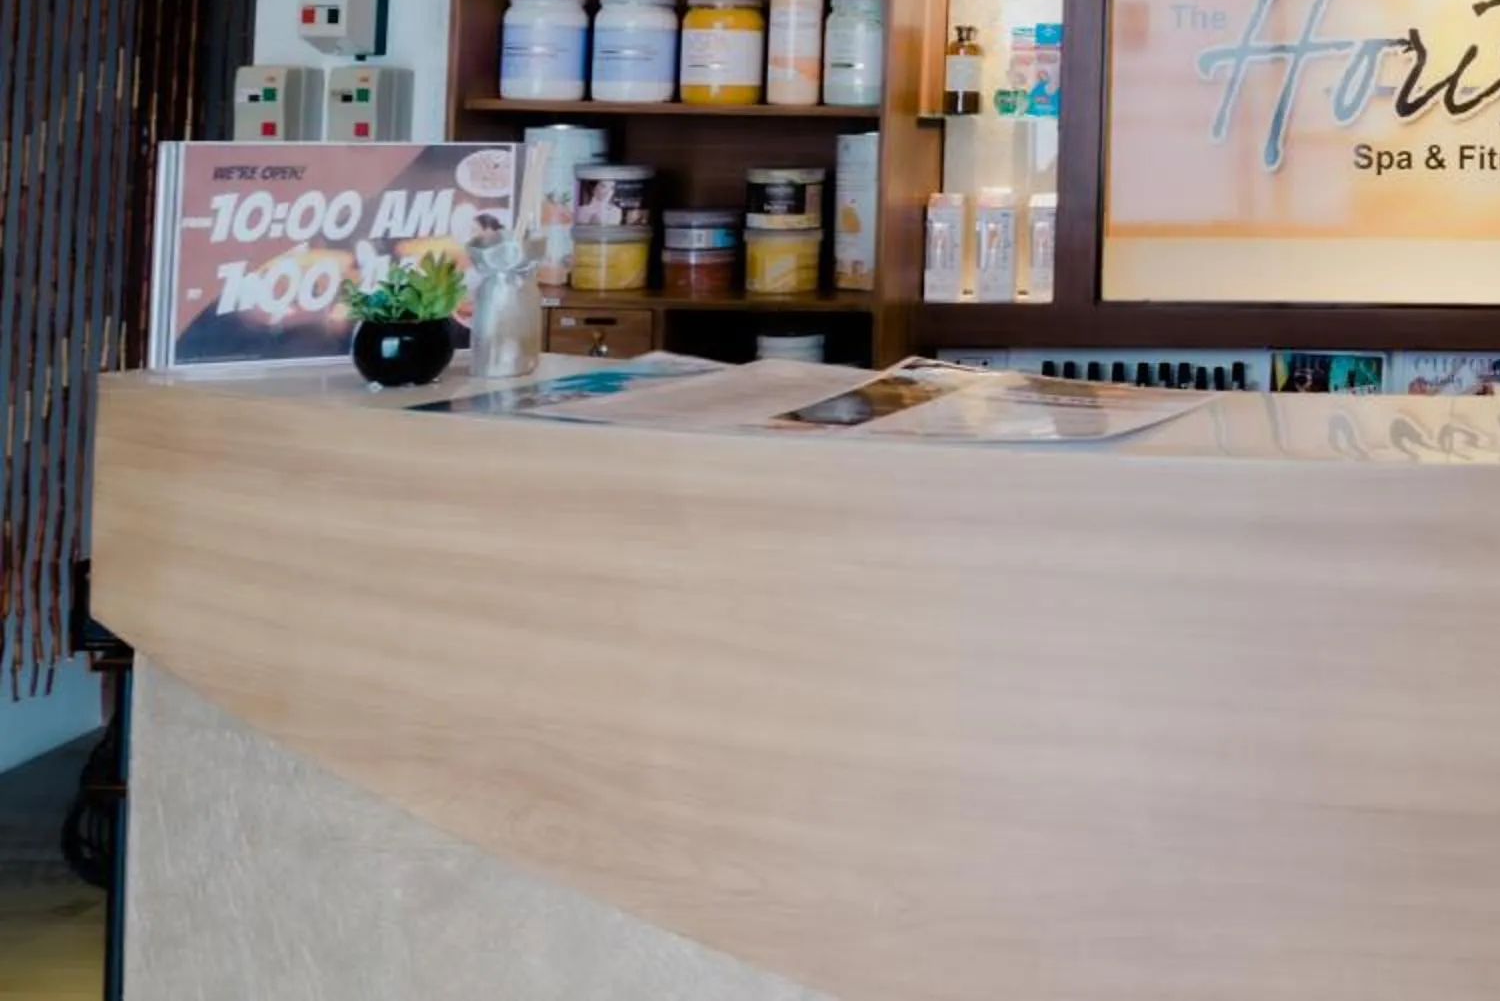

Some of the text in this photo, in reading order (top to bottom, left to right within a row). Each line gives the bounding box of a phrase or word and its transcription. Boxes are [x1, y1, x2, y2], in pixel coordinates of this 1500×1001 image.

[1169, 3, 1228, 31] The
[1353, 144, 1413, 175] Spa
[1424, 144, 1447, 170] &
[210, 188, 456, 244] 10:00 AM
